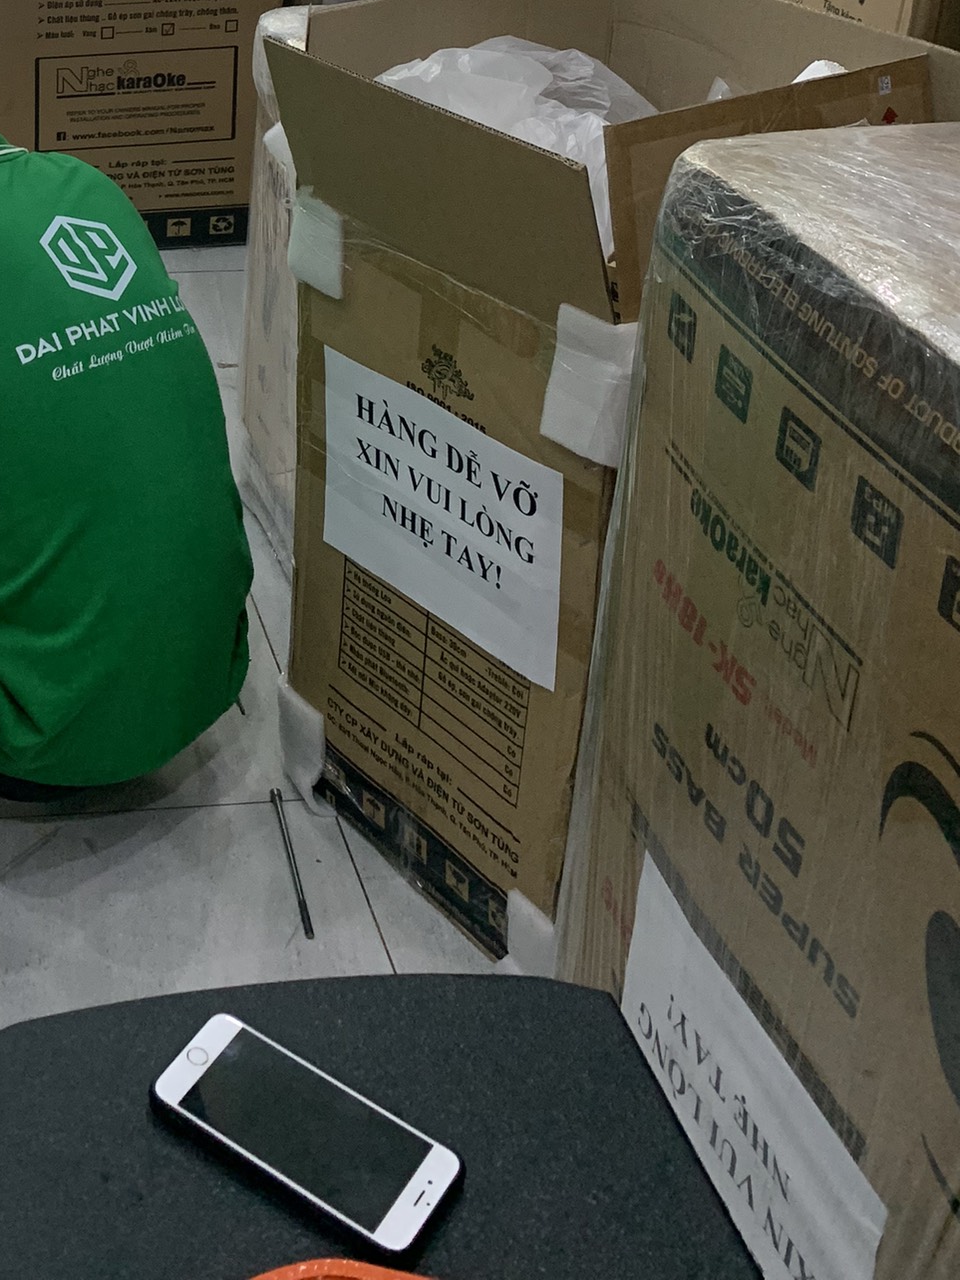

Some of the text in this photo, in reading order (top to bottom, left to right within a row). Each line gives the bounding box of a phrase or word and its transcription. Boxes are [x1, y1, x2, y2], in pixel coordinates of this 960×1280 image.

[117, 72, 186, 90] karaOke
[15, 296, 172, 365] DAI PHAT VINH
[51, 361, 85, 382] Chất
[89, 348, 124, 369] Lượng
[125, 335, 155, 355] Vượt
[156, 326, 183, 344] Niềm
[797, 303, 879, 379] SONTUNG
[355, 393, 539, 517] HÀNG DỄ VỠ
[356, 437, 535, 564] XIN VUI LÒNG
[382, 494, 435, 549] NHẸ
[441, 529, 502, 590] TAY!
[690, 487, 771, 608] karaOke
[327, 696, 344, 716] CTY
[345, 713, 358, 727] CP
[490, 832, 519, 864] TÙNG
[705, 722, 807, 878] 50cm
[651, 722, 861, 1019] SUPER BASS
[637, 1001, 703, 1124] LÒNG
[666, 994, 791, 1203] NHẸ TAY!
[708, 1120, 755, 1212] VUI
